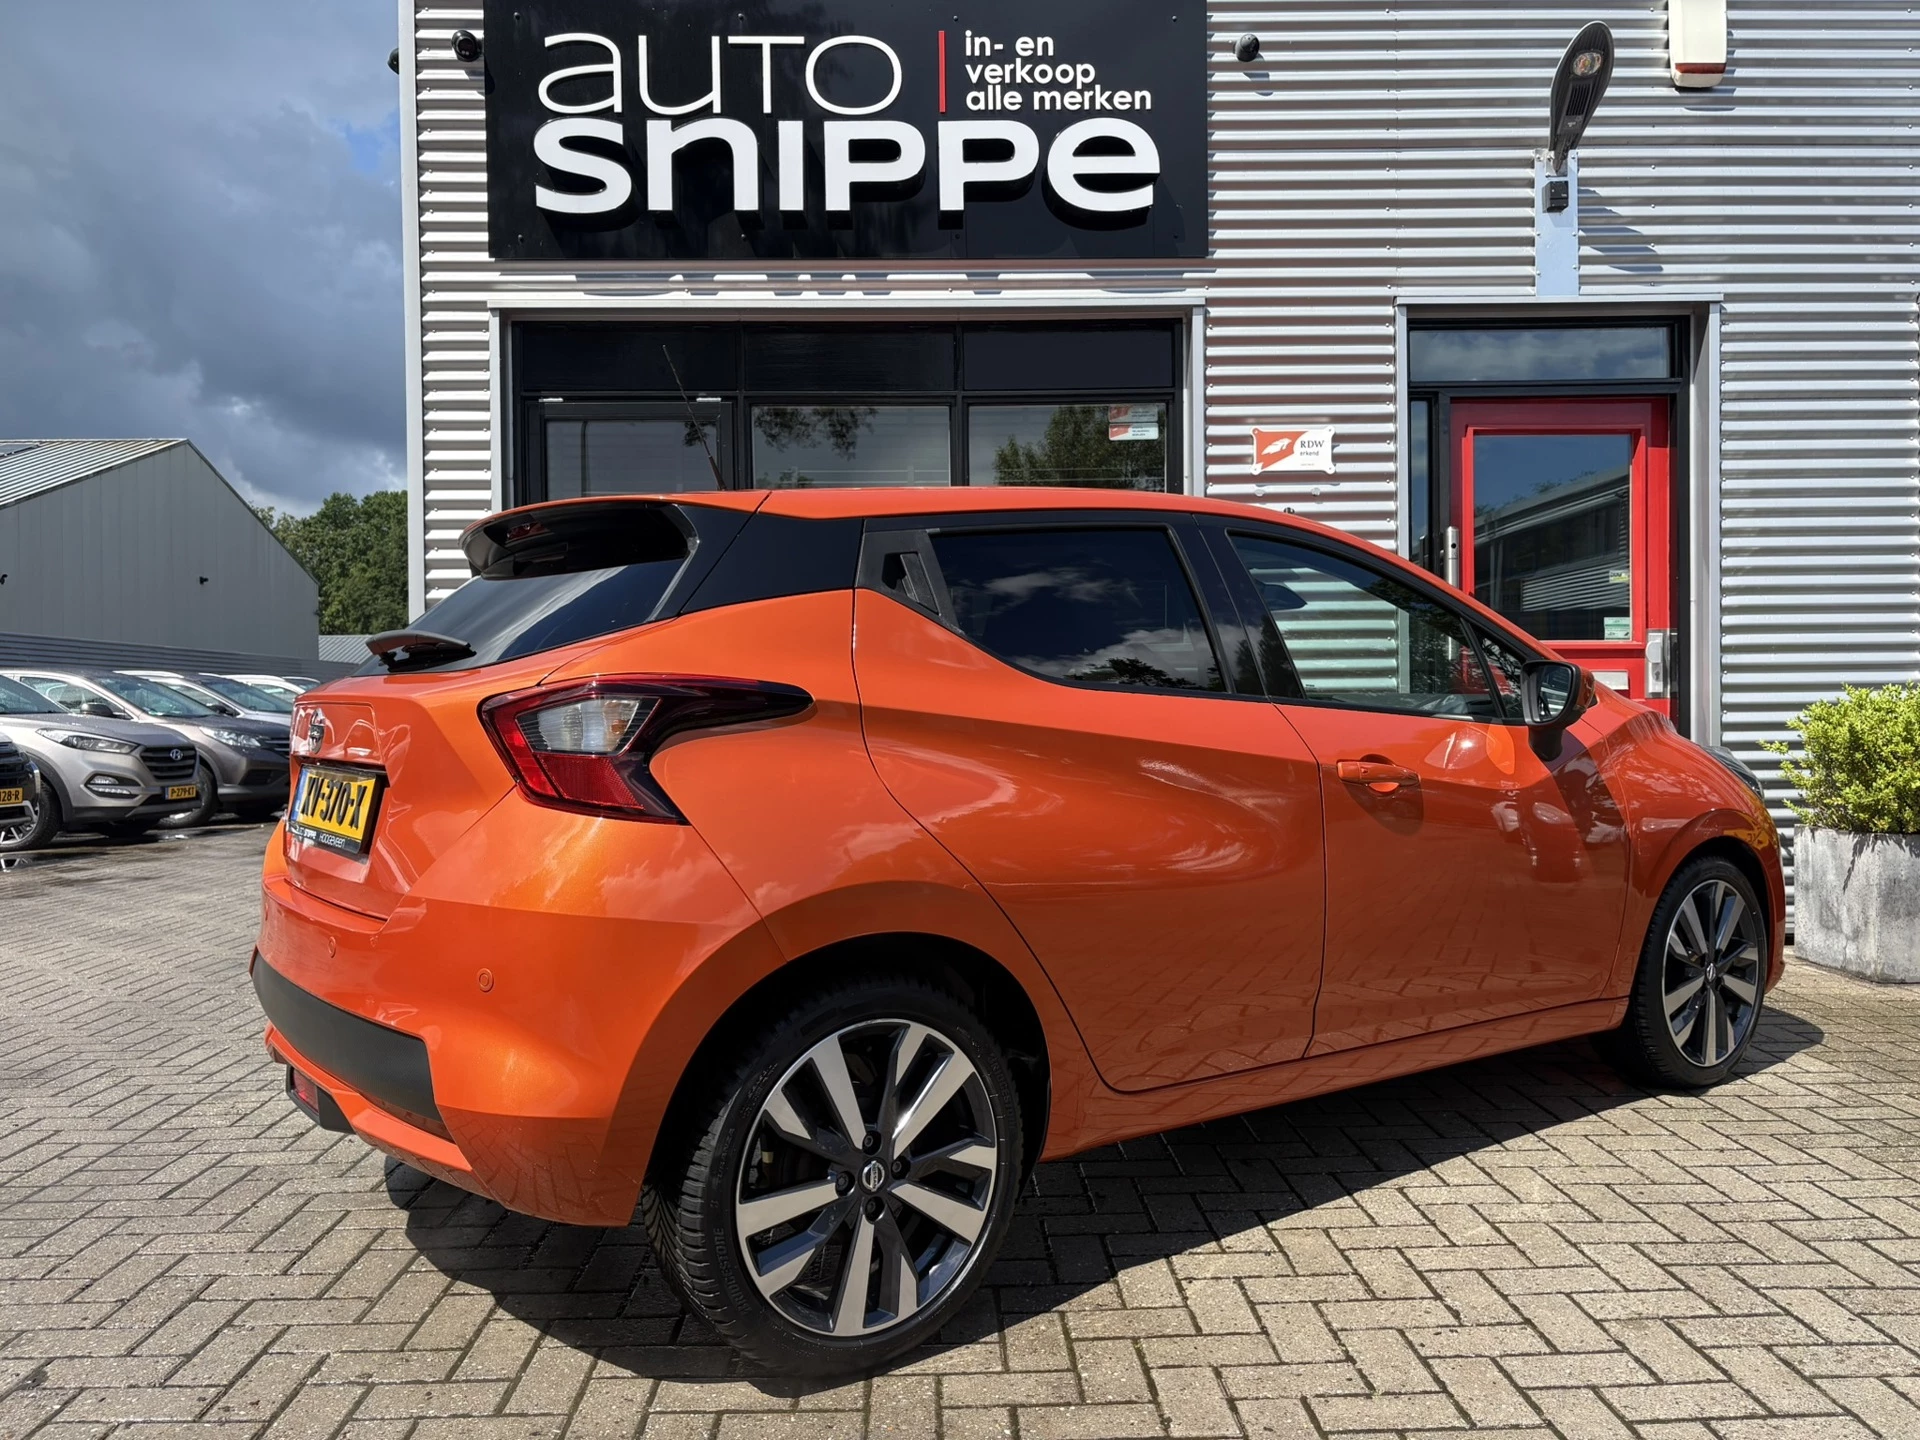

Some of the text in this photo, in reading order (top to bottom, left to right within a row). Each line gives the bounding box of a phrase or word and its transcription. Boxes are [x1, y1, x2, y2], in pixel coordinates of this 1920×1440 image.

[965, 29, 1054, 57] in- en
[964, 57, 1096, 90] verkoop
[965, 84, 1152, 111] alle merken
[1300, 440, 1325, 449] RDW
[301, 776, 367, 830] XV-370-X
